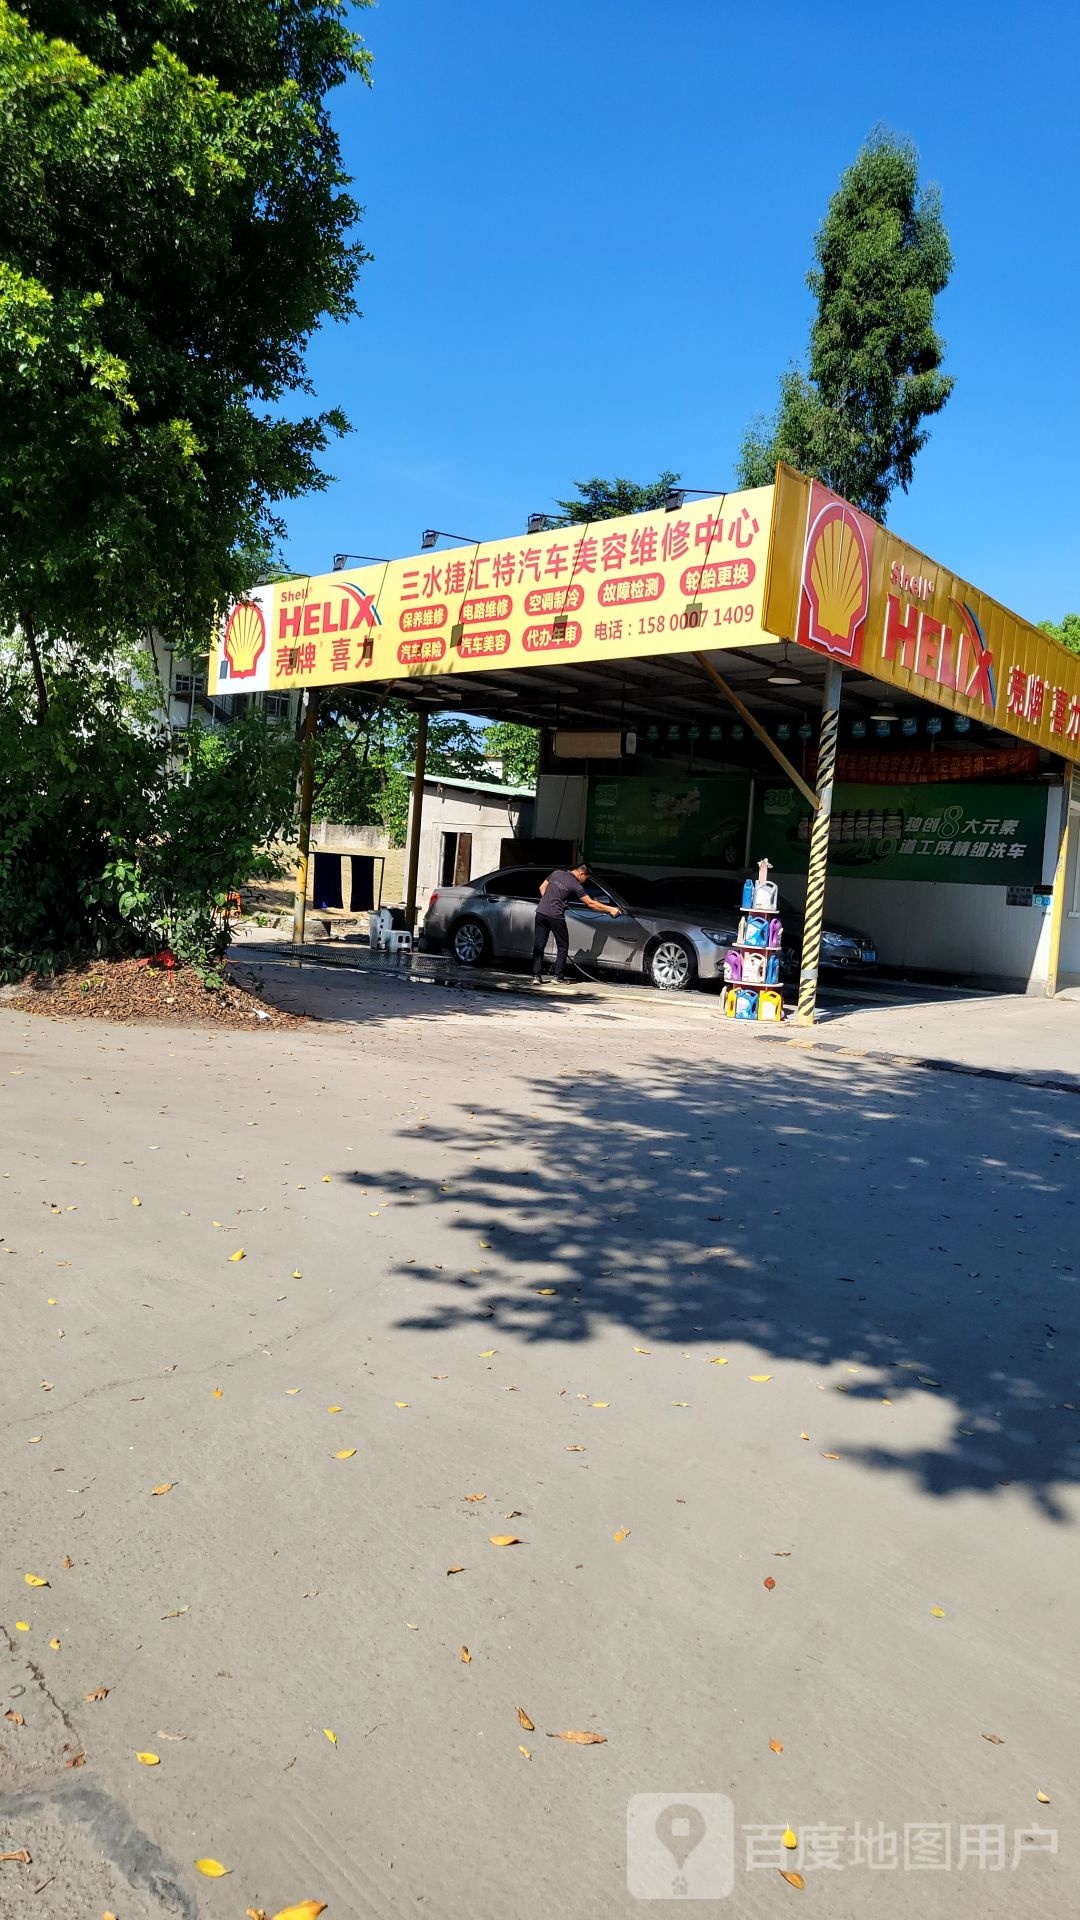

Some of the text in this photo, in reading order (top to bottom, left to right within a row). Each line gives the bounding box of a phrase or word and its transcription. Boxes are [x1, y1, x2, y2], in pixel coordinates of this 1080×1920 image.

[400, 508, 760, 601] 三水捷汇特汽车美容维修中心
[279, 592, 380, 639] HELIX
[281, 590, 308, 602] Shell
[402, 563, 750, 629] 保养维修 电路维修 空调制冷 故障检测 轮胎更换
[275, 637, 374, 677] 壳牌 喜力
[401, 642, 443, 660] 汽车保险
[461, 634, 506, 655] 汽车美容
[527, 625, 577, 648] 代办年审
[669, 609, 709, 631] 0007
[713, 604, 754, 626] 1409
[881, 592, 995, 707] HELIX
[1007, 665, 1044, 725] 壳牌
[904, 805, 1020, 838] 独创8大元素
[857, 835, 1027, 866] 19道工序精细洗车
